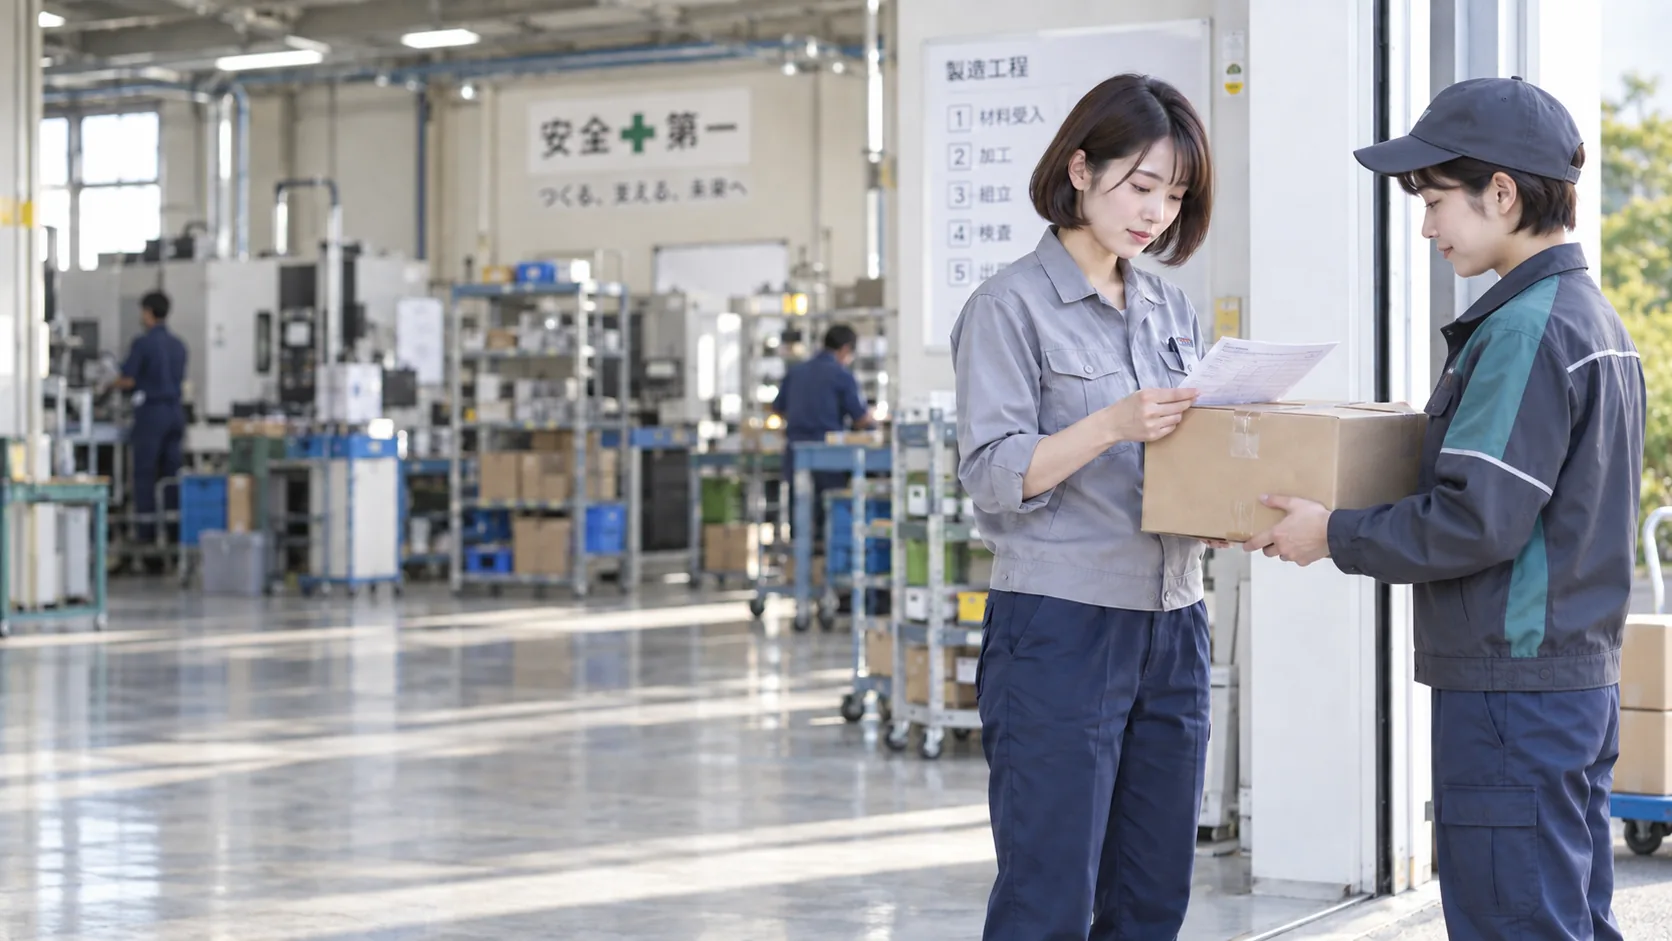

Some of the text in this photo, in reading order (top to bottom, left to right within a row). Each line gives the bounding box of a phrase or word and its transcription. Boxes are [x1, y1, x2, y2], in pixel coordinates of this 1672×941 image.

[947, 56, 1028, 81] 製造工程
[956, 106, 1045, 128] 1 材料受入
[541, 111, 738, 159] 安全 第一
[954, 147, 1012, 166] 2 加工
[954, 185, 1011, 204] 3 組立
[953, 224, 1011, 242] 4 検査
[954, 262, 1012, 281] 5 出
